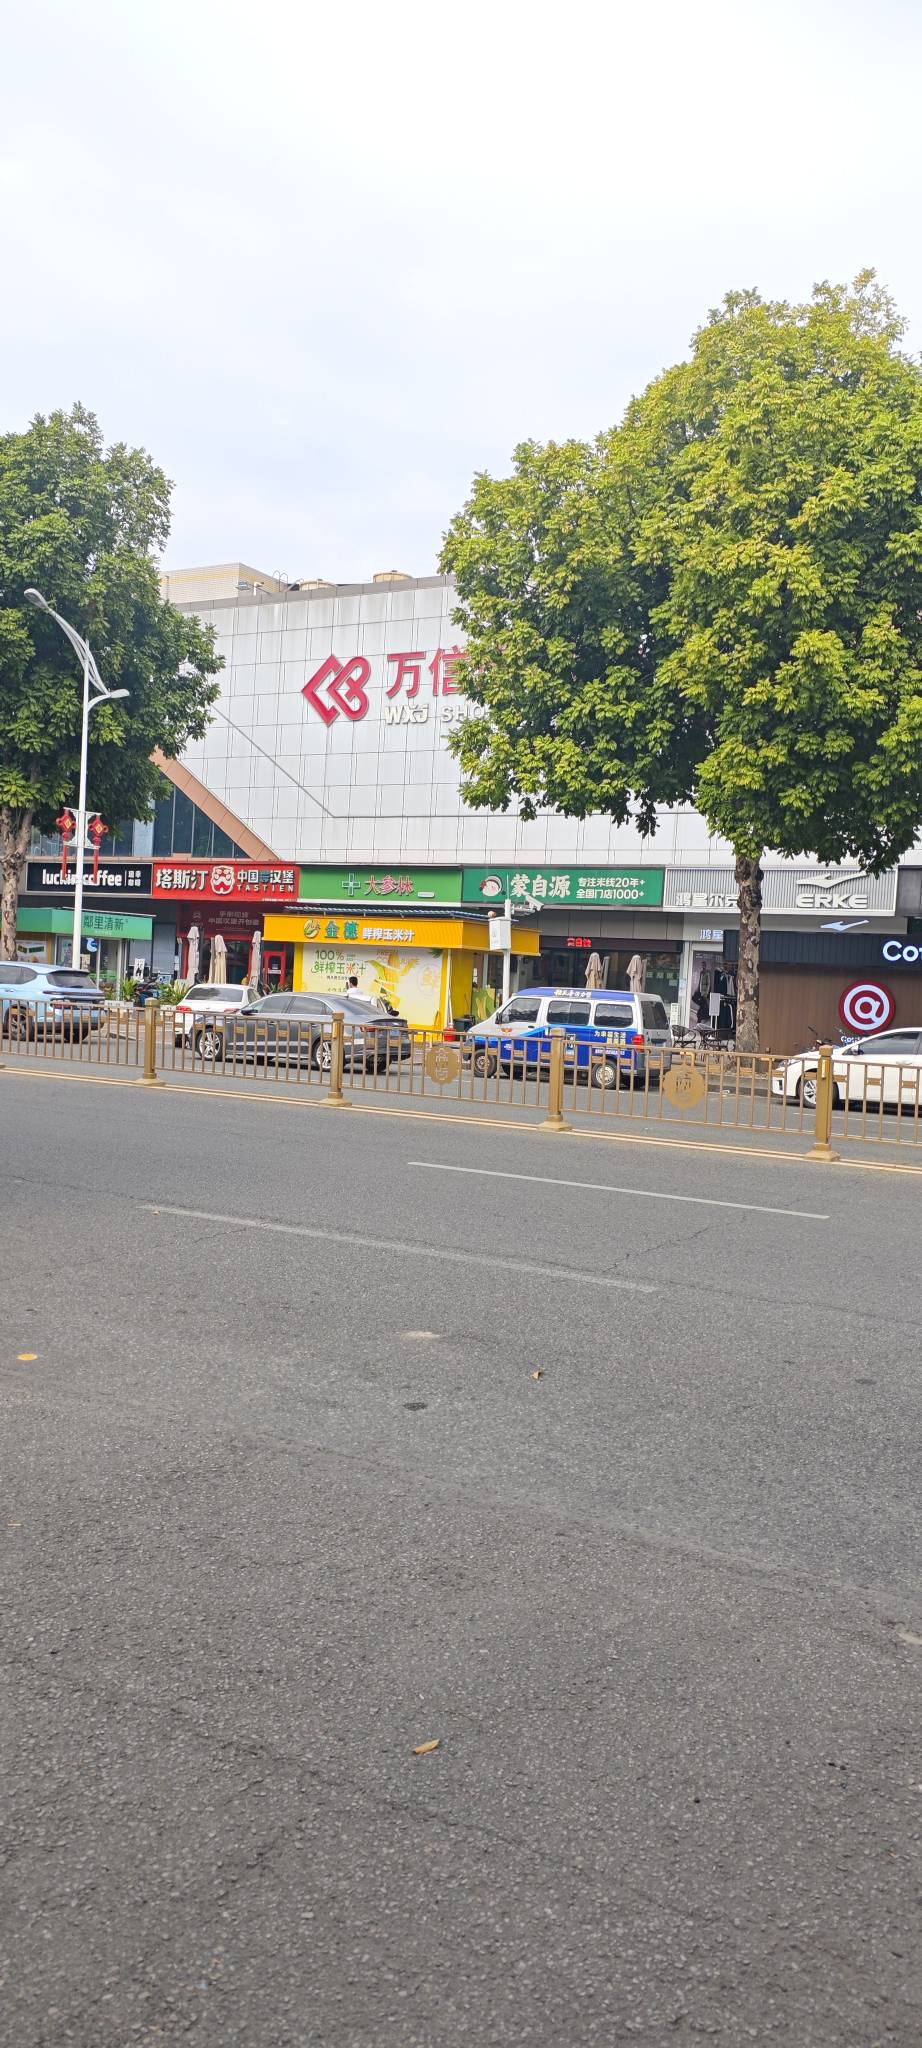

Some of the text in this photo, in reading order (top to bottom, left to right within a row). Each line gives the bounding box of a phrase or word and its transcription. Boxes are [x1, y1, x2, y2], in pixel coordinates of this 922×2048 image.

[387, 645, 486, 698] 万信
[155, 868, 208, 890] 塔斯汀
[510, 873, 571, 898] 蒙自源
[577, 877, 645, 888] 专注米线20年+
[237, 884, 294, 892] TASTIEN
[576, 888, 645, 899] 全国门店1000+
[796, 894, 869, 909] ERKE
[315, 949, 345, 960] 100%
[882, 940, 922, 962] Co
[311, 961, 367, 976] 鲜榨玉米汁
